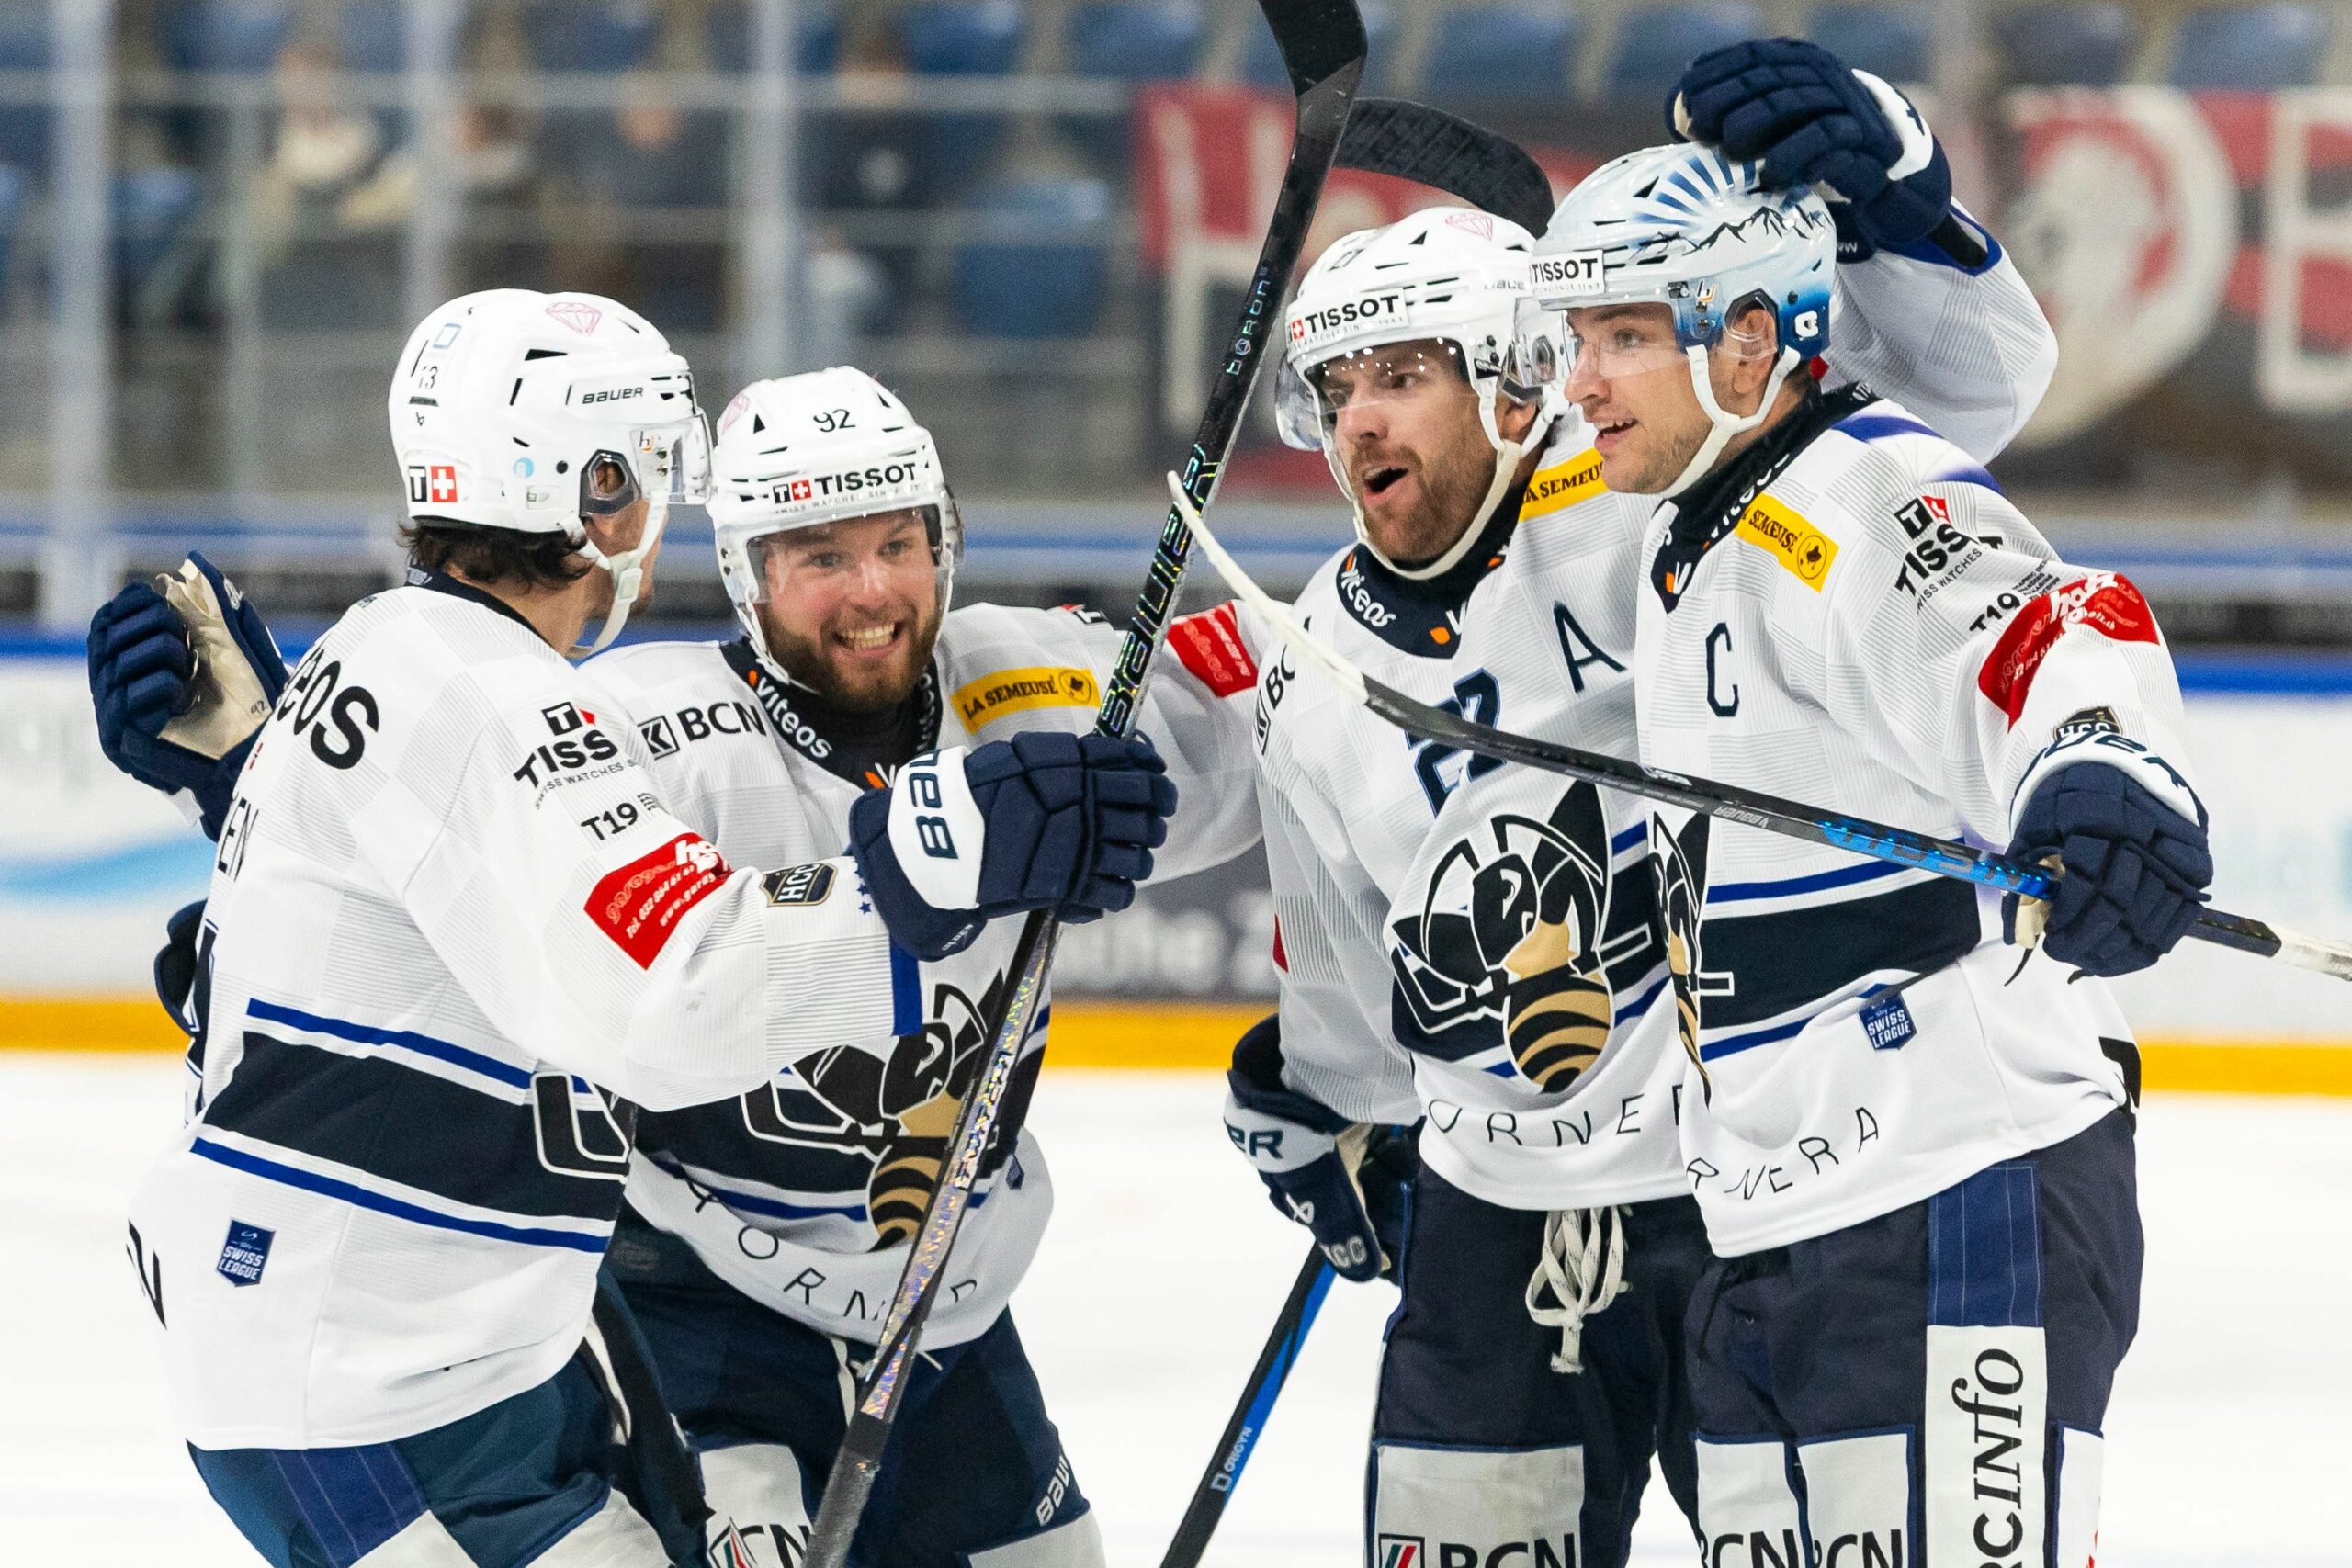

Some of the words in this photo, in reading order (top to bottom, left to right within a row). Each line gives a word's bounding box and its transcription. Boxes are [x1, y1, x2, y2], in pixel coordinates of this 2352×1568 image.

[1531, 257, 1599, 284] TISSOT
[1305, 294, 1399, 333] TISSOT
[582, 387, 644, 405] BAUER
[812, 408, 856, 433] 92
[814, 461, 916, 496] TISSOT
[1937, 547, 1983, 588] WATCHES
[1969, 592, 2021, 632] T19
[1553, 600, 1627, 694] A
[1705, 622, 1740, 717] C
[754, 676, 833, 764] viteos
[962, 692, 984, 719] LA
[676, 701, 767, 743] BCN
[562, 761, 624, 786] WATCHES
[581, 802, 639, 841] T19
[1867, 1009, 1906, 1037] SWISS
[1871, 1020, 1911, 1049] LEAGUE
[218, 1258, 262, 1280] LEAGUE
[223, 1246, 265, 1268] SWISS
